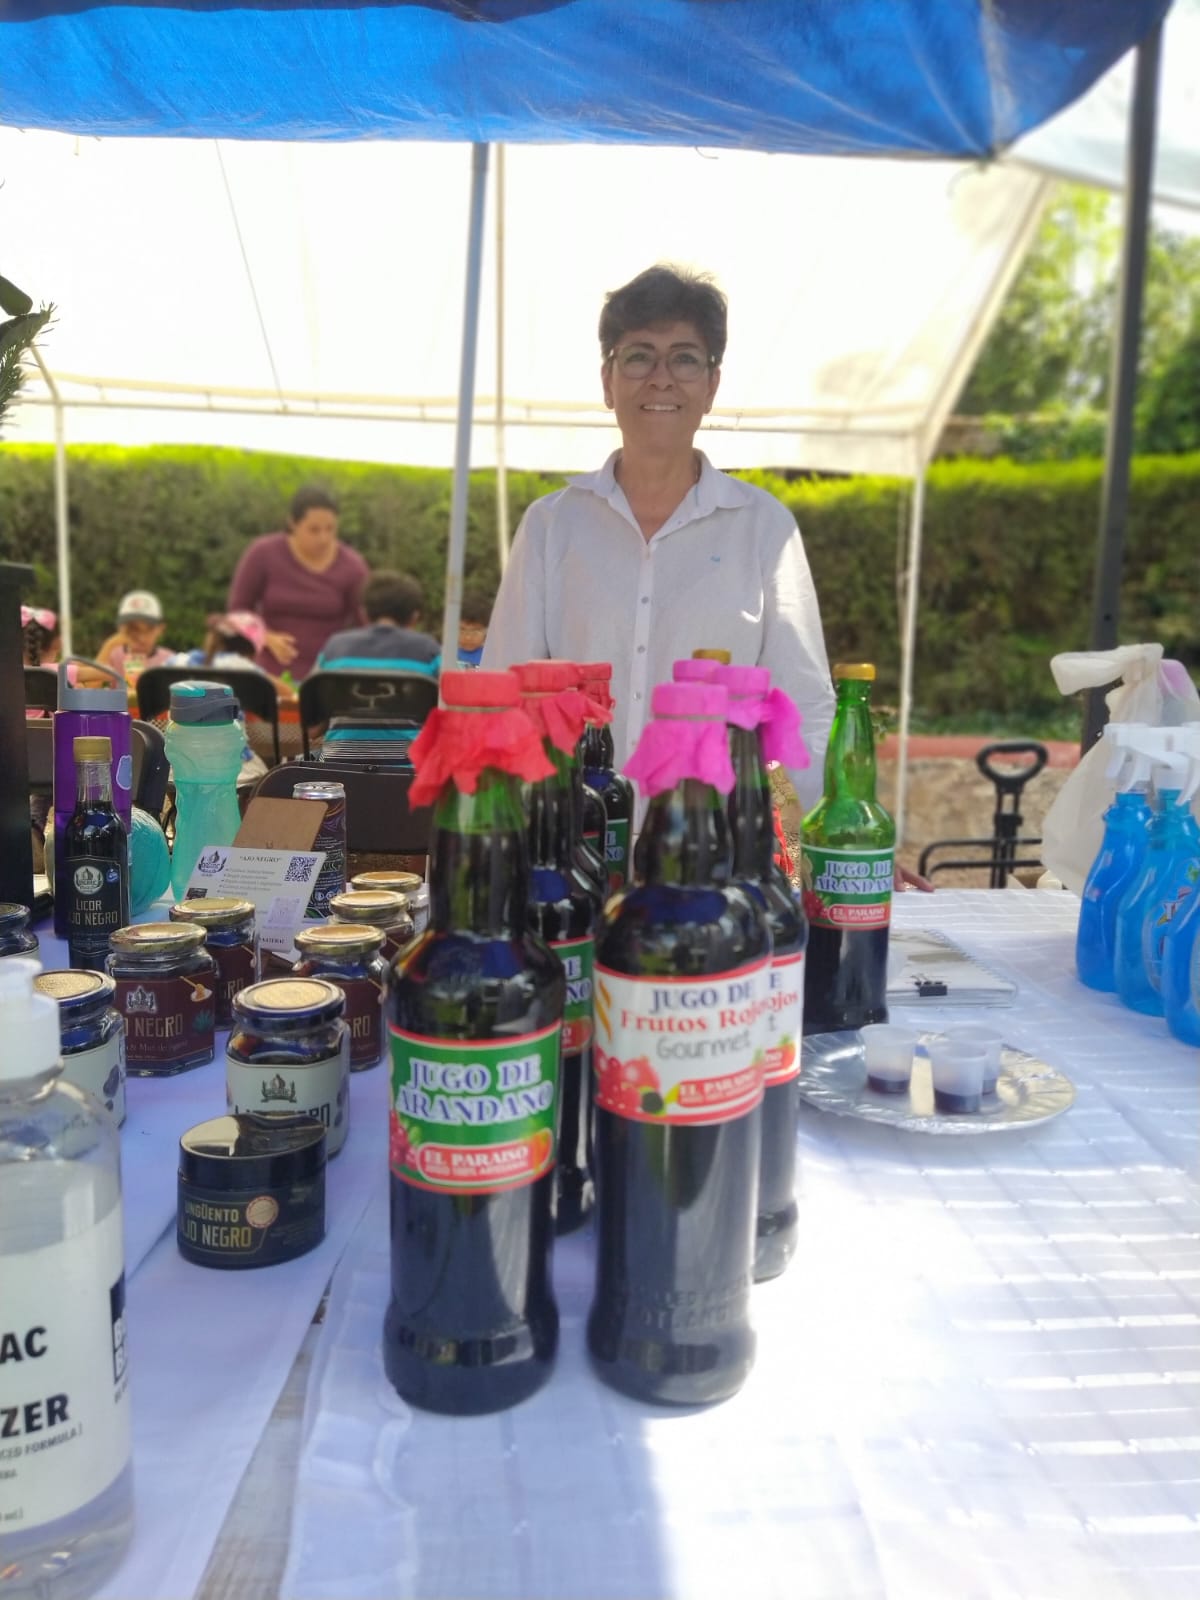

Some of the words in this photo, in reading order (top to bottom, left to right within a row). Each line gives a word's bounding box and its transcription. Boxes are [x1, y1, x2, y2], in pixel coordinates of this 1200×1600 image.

[826, 861, 869, 877] JUGO
[874, 861, 891, 875] DE
[817, 876, 893, 893] ARANDAN
[76, 899, 102, 911] LICOR
[84, 911, 118, 926] NEGRO
[649, 987, 718, 1014] JUGO
[728, 981, 753, 1004] DE
[135, 1014, 183, 1038] NEGRO
[620, 1010, 709, 1033] Frutos
[655, 1030, 751, 1060] Gourmet
[409, 1060, 489, 1091] JUGO
[499, 1057, 541, 1089] DE
[398, 1081, 553, 1122] ARANDANO
[425, 1149, 448, 1164] EL
[451, 1146, 529, 1167] PARAISO
[201, 1223, 252, 1249] NEGRO
